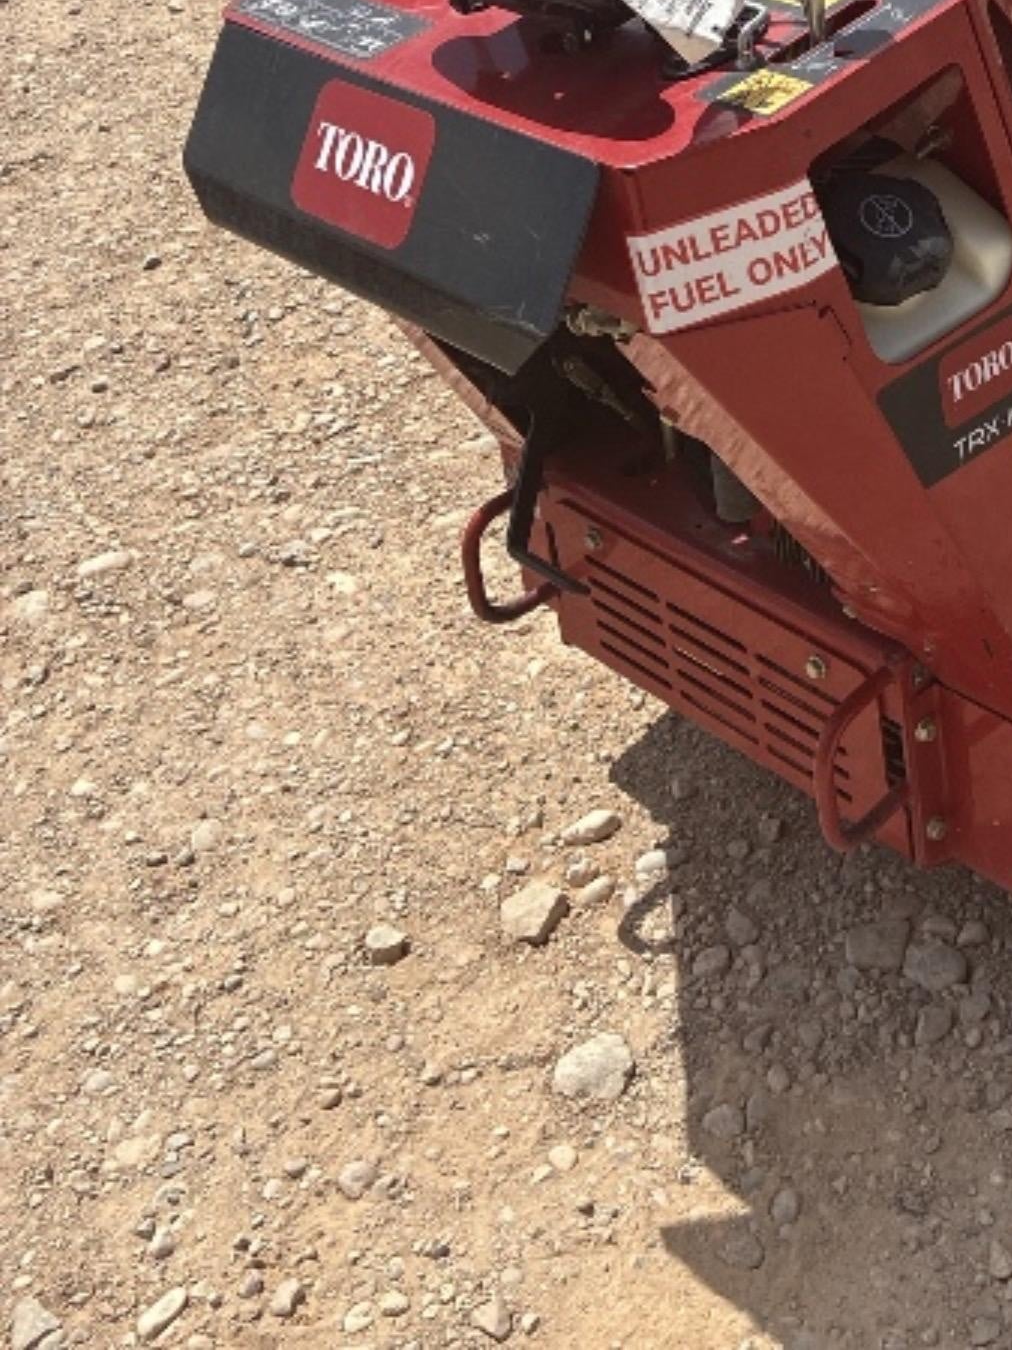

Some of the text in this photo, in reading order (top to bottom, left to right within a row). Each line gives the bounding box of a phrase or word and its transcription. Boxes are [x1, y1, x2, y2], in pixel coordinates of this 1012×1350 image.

[314, 121, 415, 202] TORO
[637, 192, 819, 277] UNLEADED
[648, 230, 828, 319] FUEL ONLY
